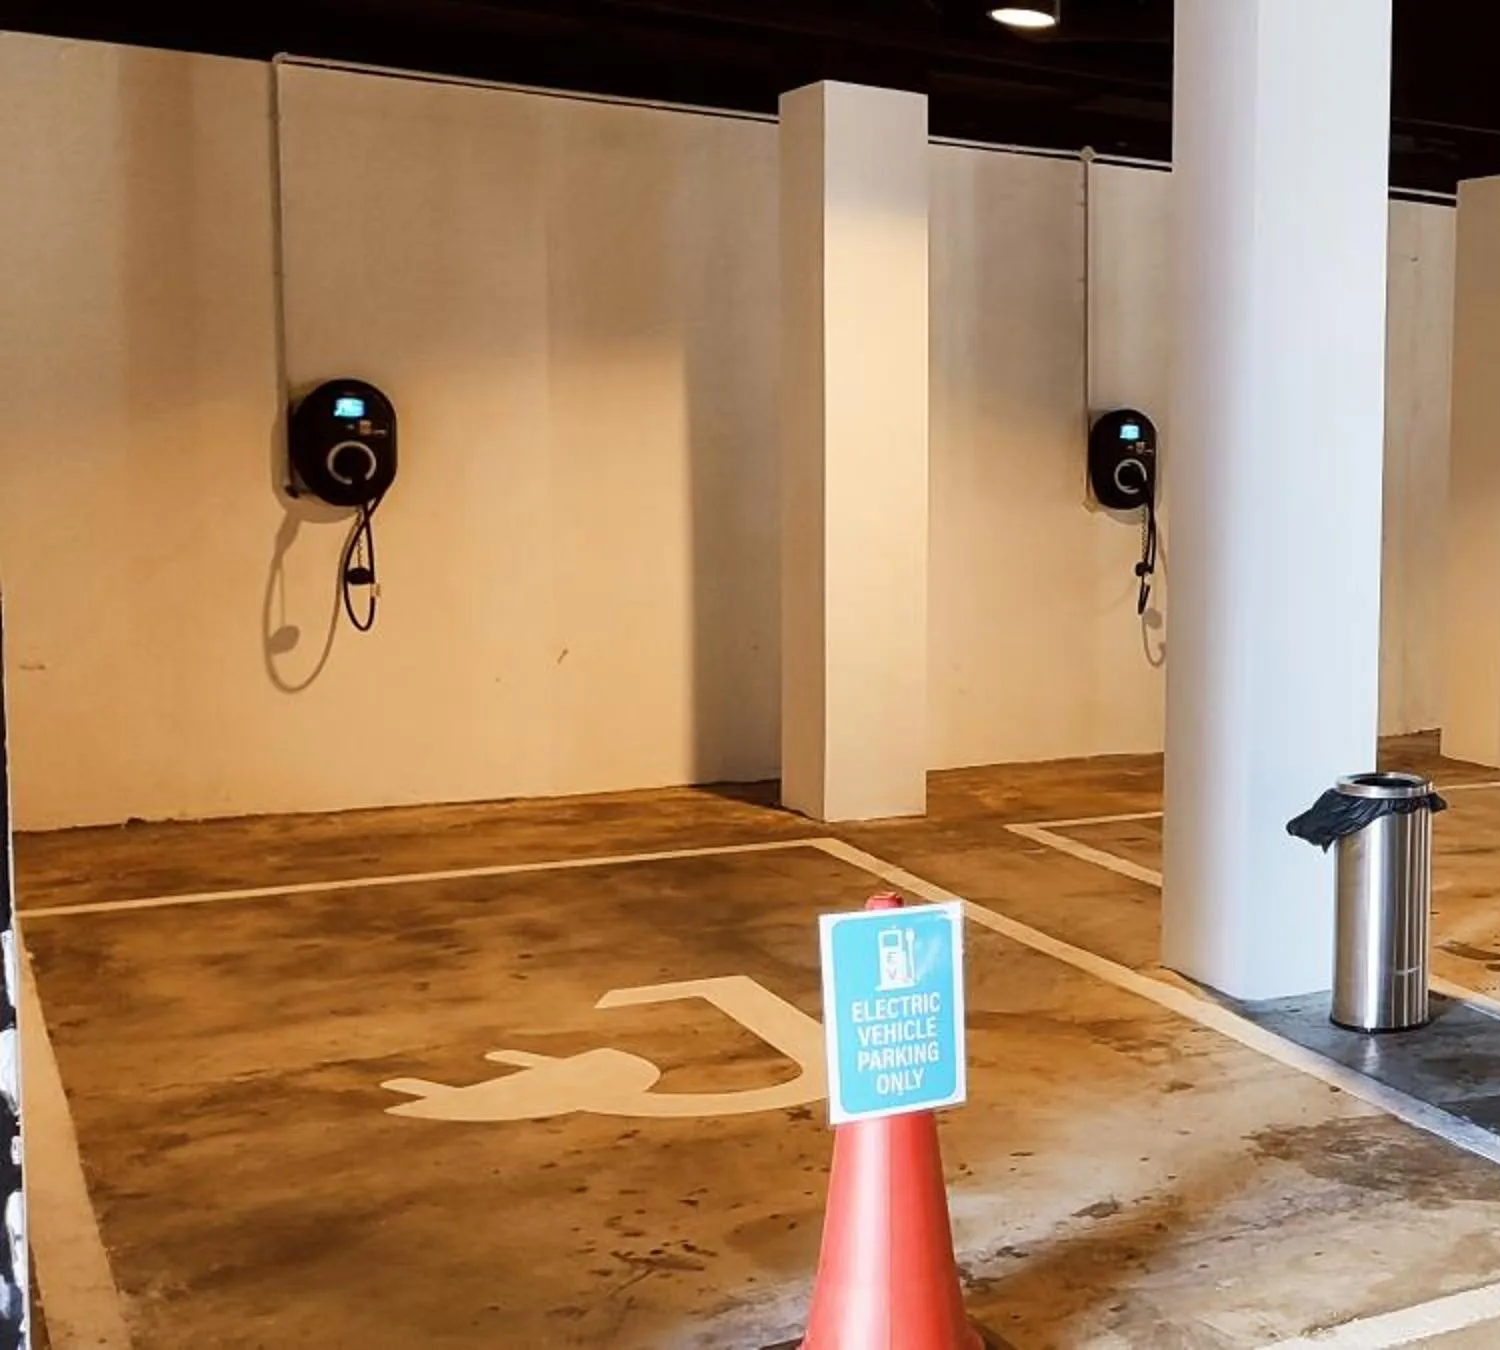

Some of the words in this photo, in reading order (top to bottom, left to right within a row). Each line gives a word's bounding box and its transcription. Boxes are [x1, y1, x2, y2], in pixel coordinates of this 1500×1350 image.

[852, 992, 941, 1023] ELECTRIC
[857, 1016, 938, 1047] VEHICLE
[857, 1041, 940, 1073] PARKING
[876, 1068, 924, 1096] ONLY
